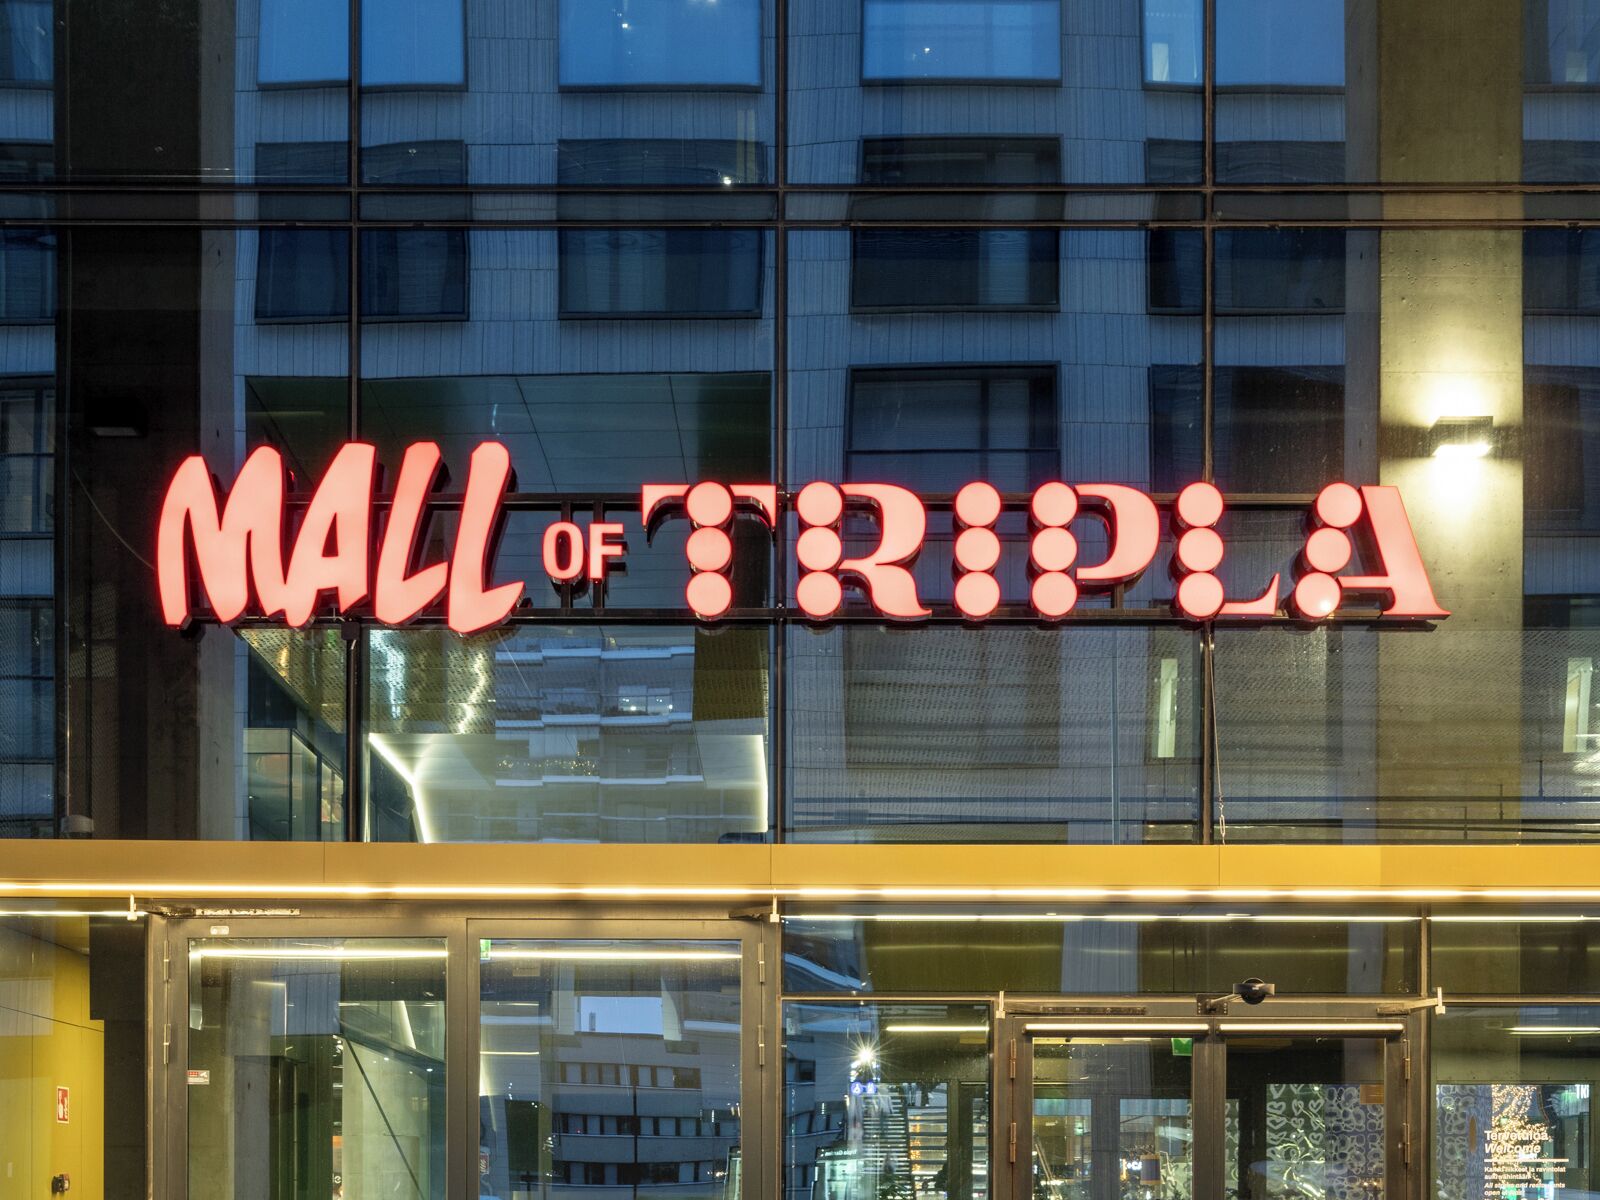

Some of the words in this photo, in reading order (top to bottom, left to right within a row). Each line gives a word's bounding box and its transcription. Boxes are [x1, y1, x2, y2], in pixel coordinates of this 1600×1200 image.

[157, 440, 526, 634] MALL
[542, 521, 625, 581] OF
[641, 480, 1452, 619] TRIPLA
[1484, 1130, 1549, 1141] Tervetuloa
[1484, 1143, 1541, 1154] Welcome
